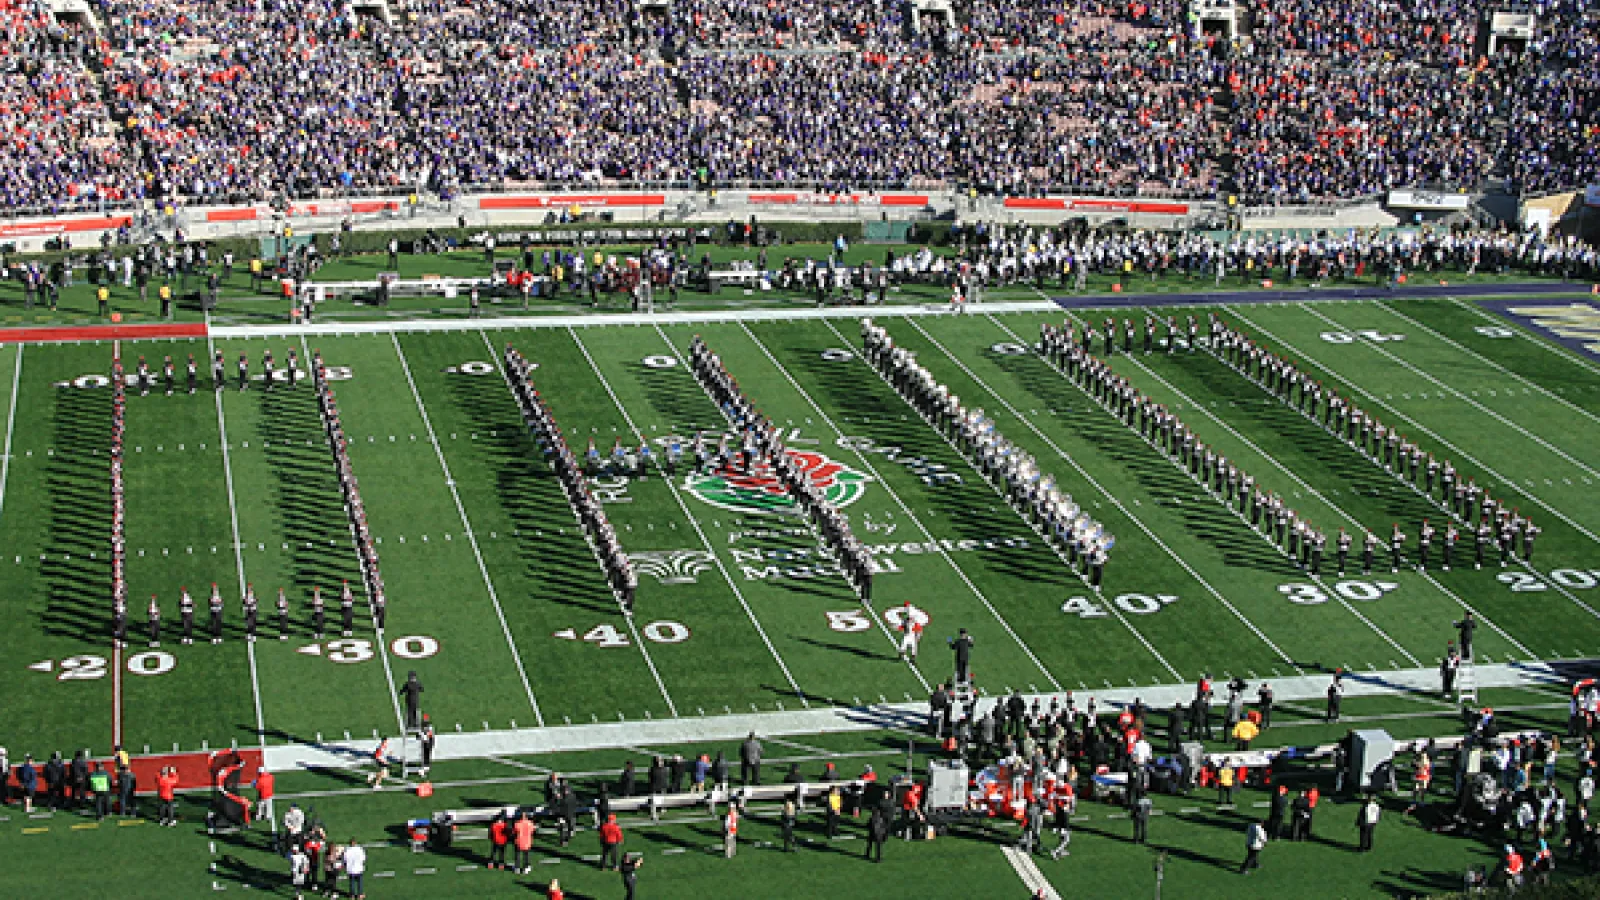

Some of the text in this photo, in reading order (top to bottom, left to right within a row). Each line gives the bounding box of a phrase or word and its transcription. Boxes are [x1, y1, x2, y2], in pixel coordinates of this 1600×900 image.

[1061, 592, 1165, 618] 40
[1277, 580, 1385, 605] 30
[583, 620, 692, 648] 40
[325, 635, 441, 664] 30
[57, 651, 178, 681] 20
